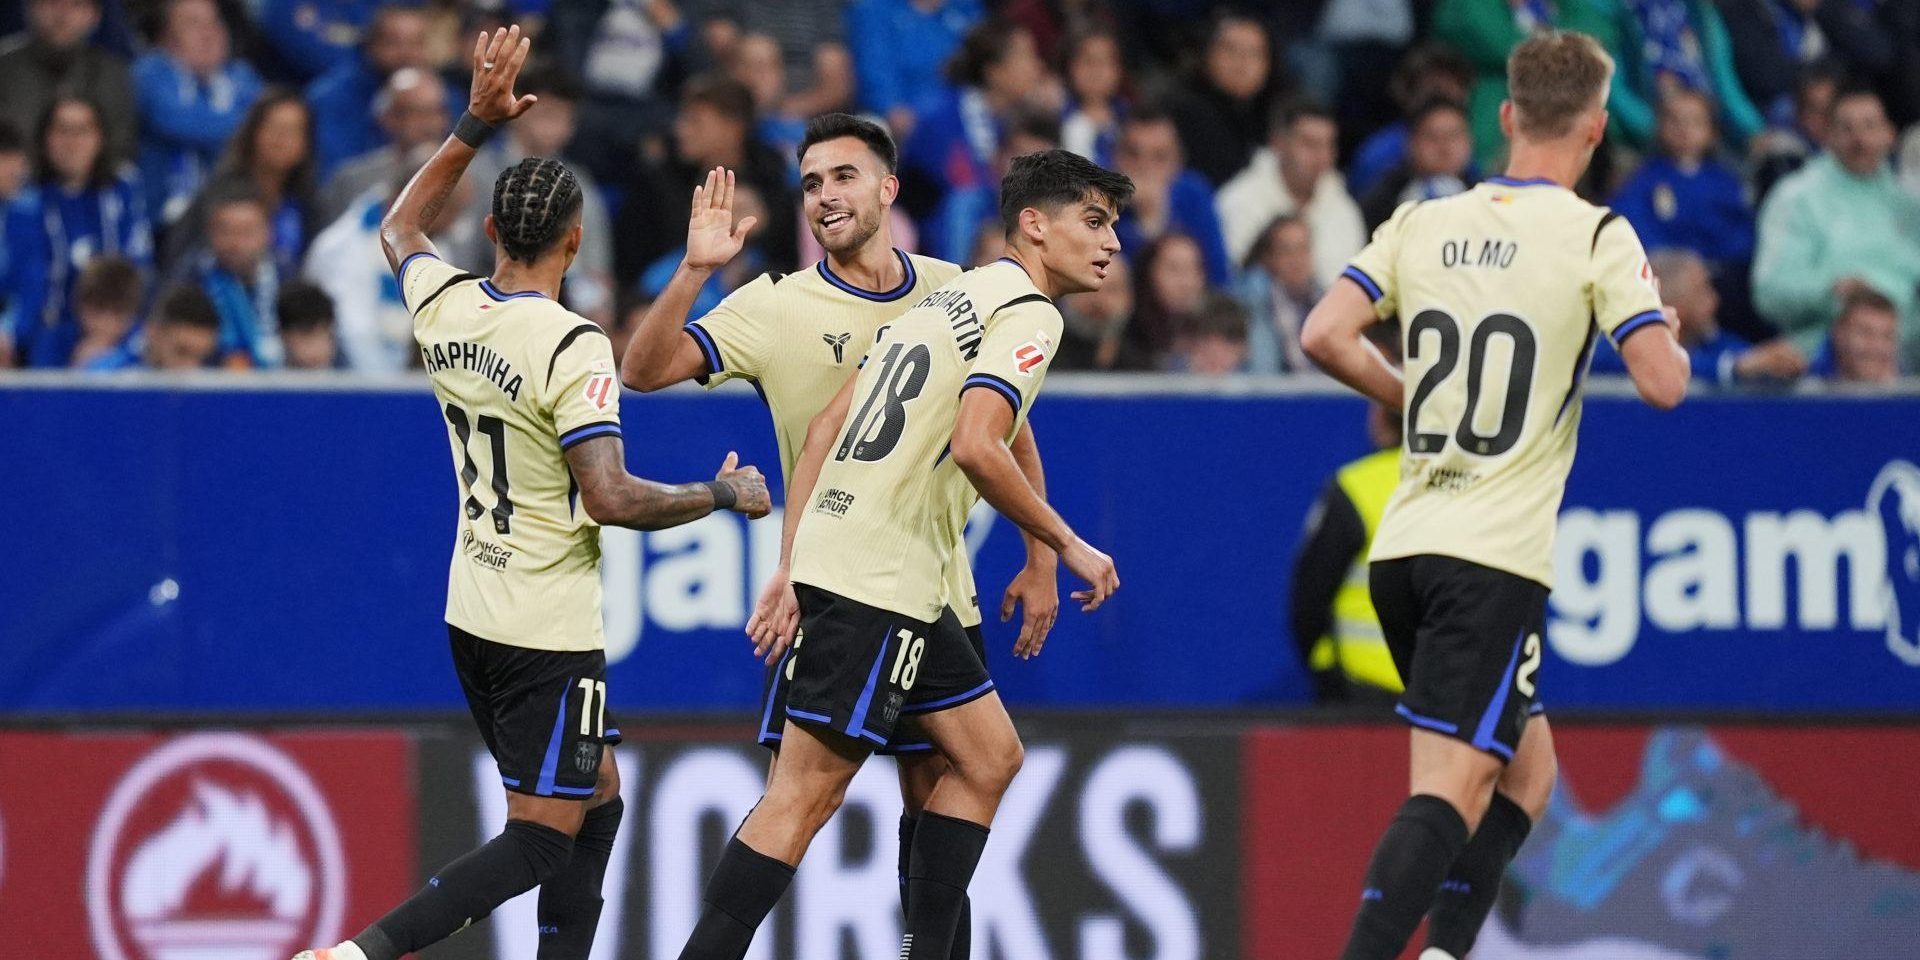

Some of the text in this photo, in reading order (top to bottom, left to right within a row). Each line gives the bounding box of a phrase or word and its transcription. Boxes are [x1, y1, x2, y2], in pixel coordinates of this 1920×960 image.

[1442, 240, 1518, 269] OLMO
[423, 341, 523, 402] RAPHINHA
[834, 343, 931, 461] 18
[1407, 309, 1536, 456] 20
[446, 402, 514, 535] 11
[1547, 507, 1888, 667] gam
[889, 628, 925, 691] 18
[577, 677, 606, 738] 11
